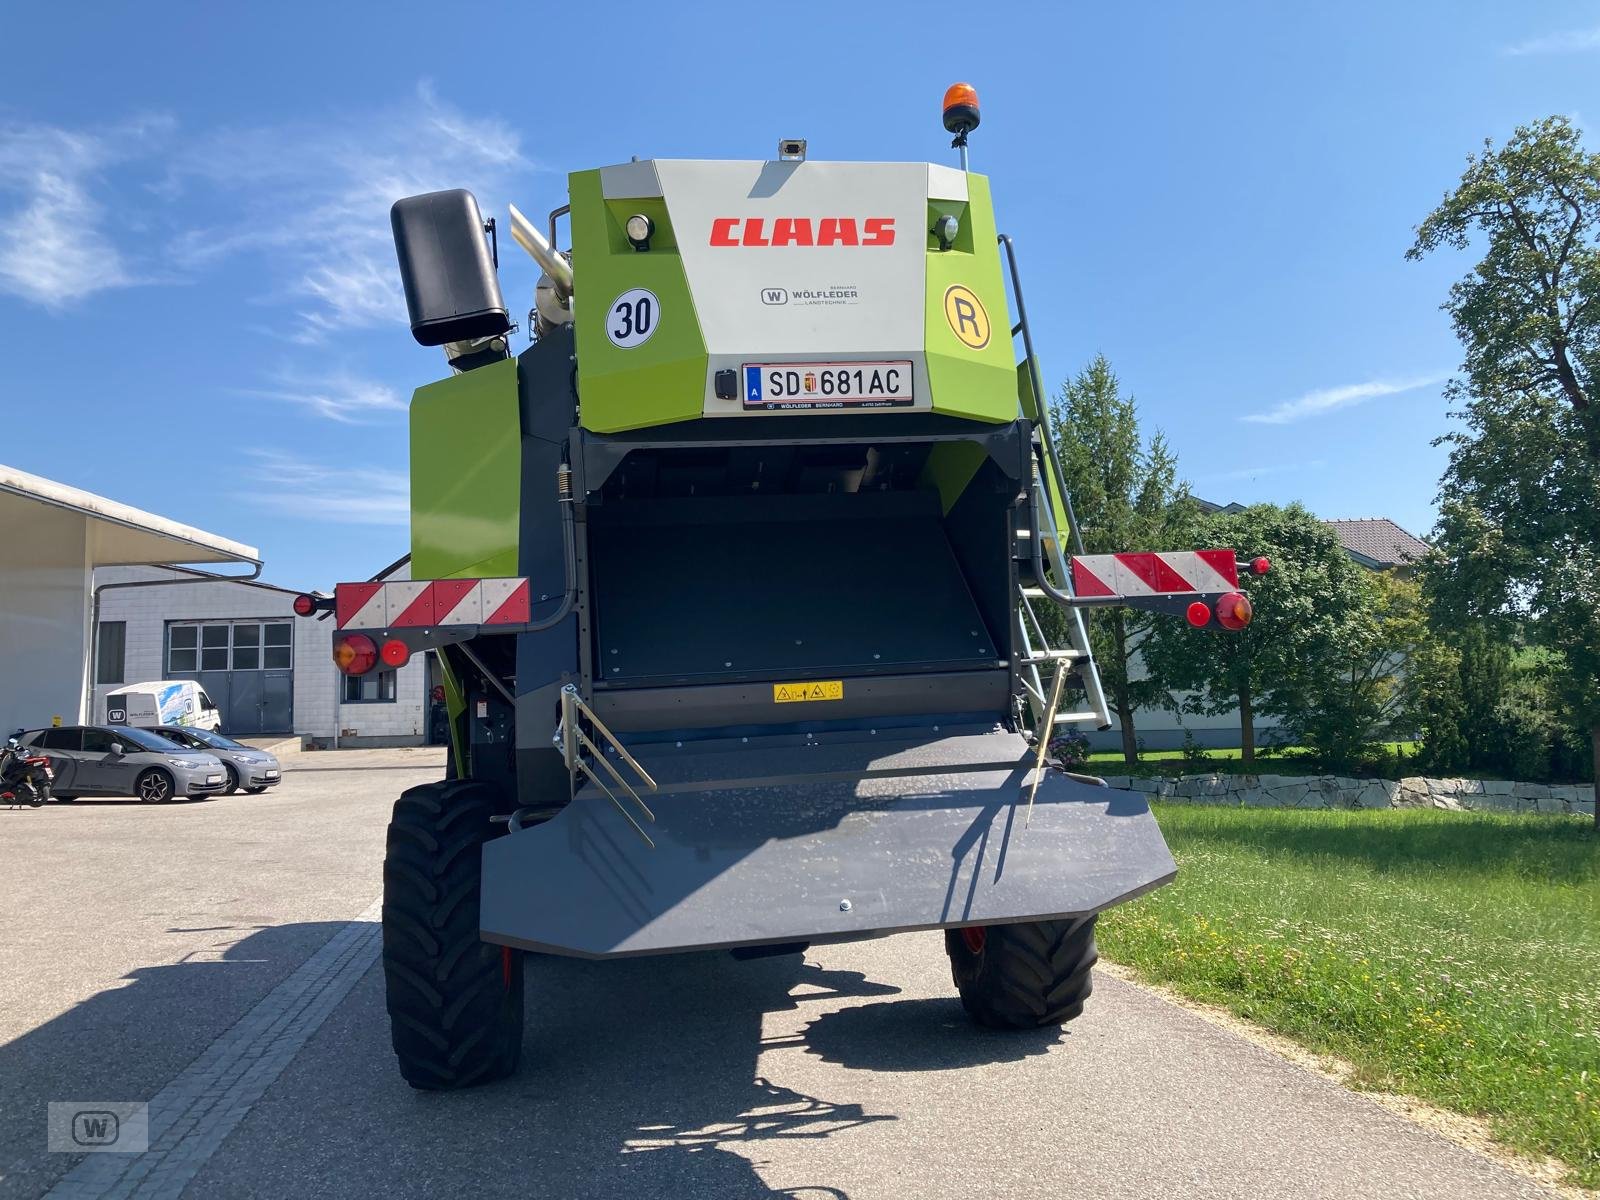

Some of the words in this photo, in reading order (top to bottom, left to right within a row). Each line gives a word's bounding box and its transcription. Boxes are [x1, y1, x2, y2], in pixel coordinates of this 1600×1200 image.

[709, 218, 896, 246] CLAAS
[767, 291, 781, 302] W
[792, 289, 858, 299] WÖLFLEDER
[614, 297, 651, 339] 30
[954, 296, 981, 338] R
[751, 388, 759, 397] A
[769, 371, 800, 396] SD
[820, 369, 900, 395] 681AC
